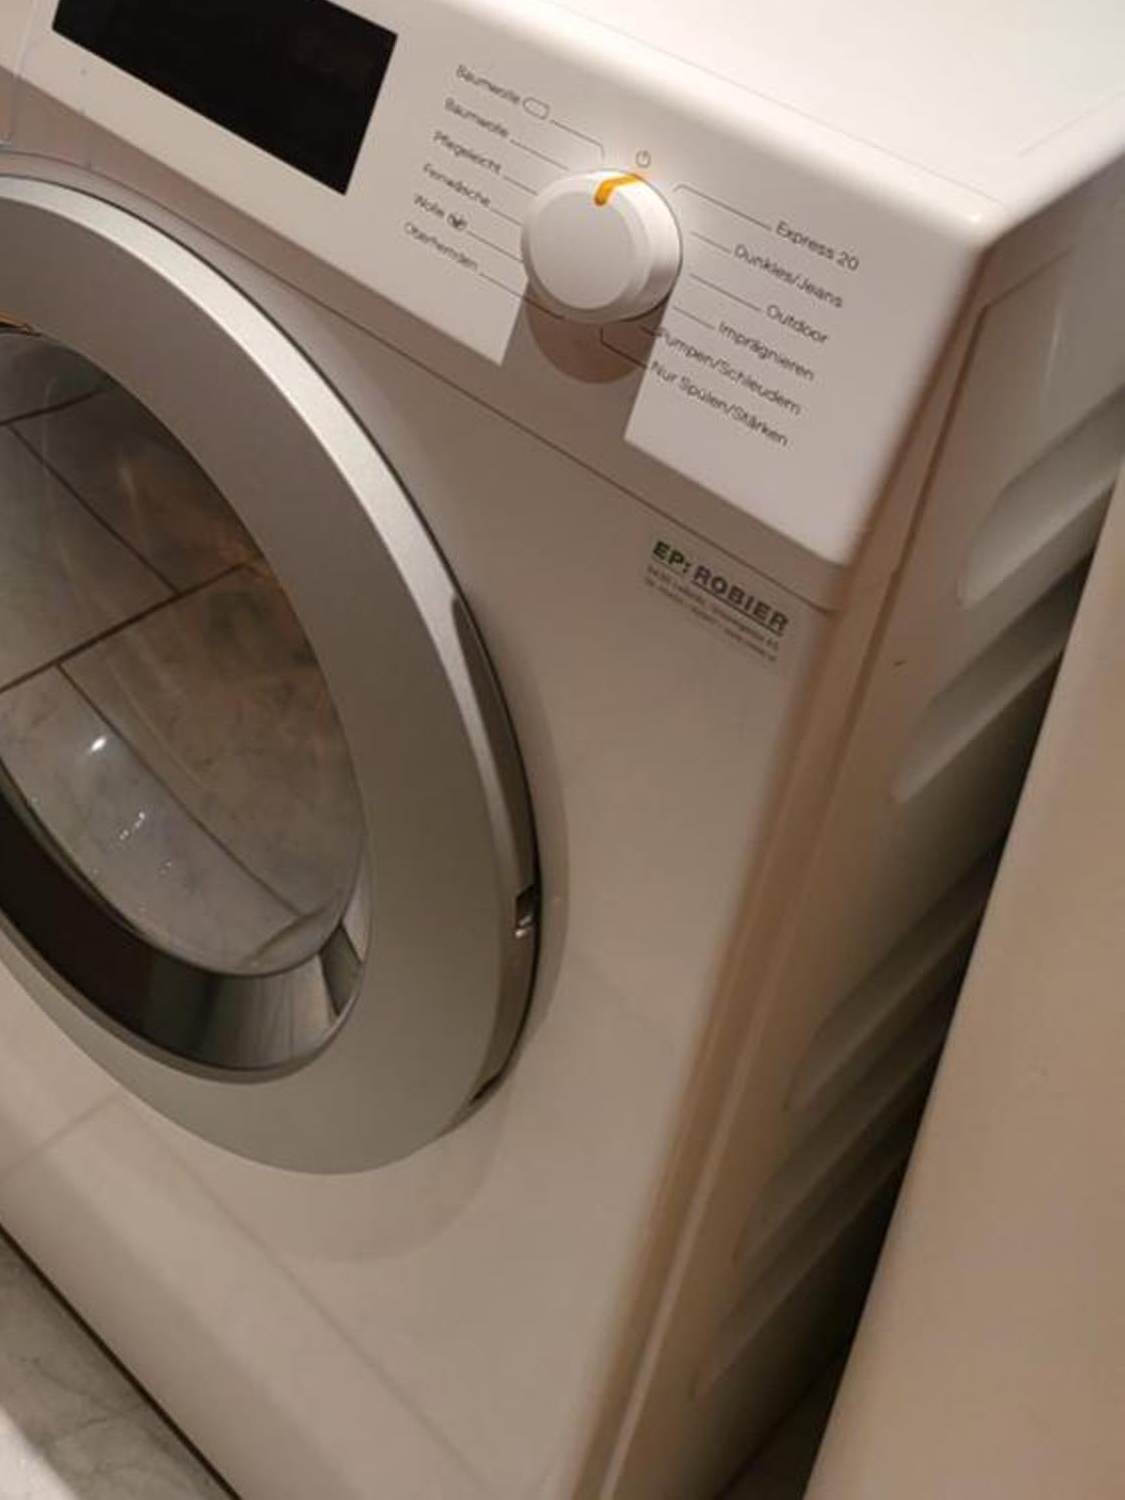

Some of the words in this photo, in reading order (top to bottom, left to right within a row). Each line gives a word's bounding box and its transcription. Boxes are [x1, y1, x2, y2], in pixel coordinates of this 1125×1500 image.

[775, 220, 835, 260] Express
[836, 250, 860, 271] 20
[766, 304, 828, 344] Outdoor
[649, 359, 678, 382] Nur
[692, 564, 790, 634] ROBIER
